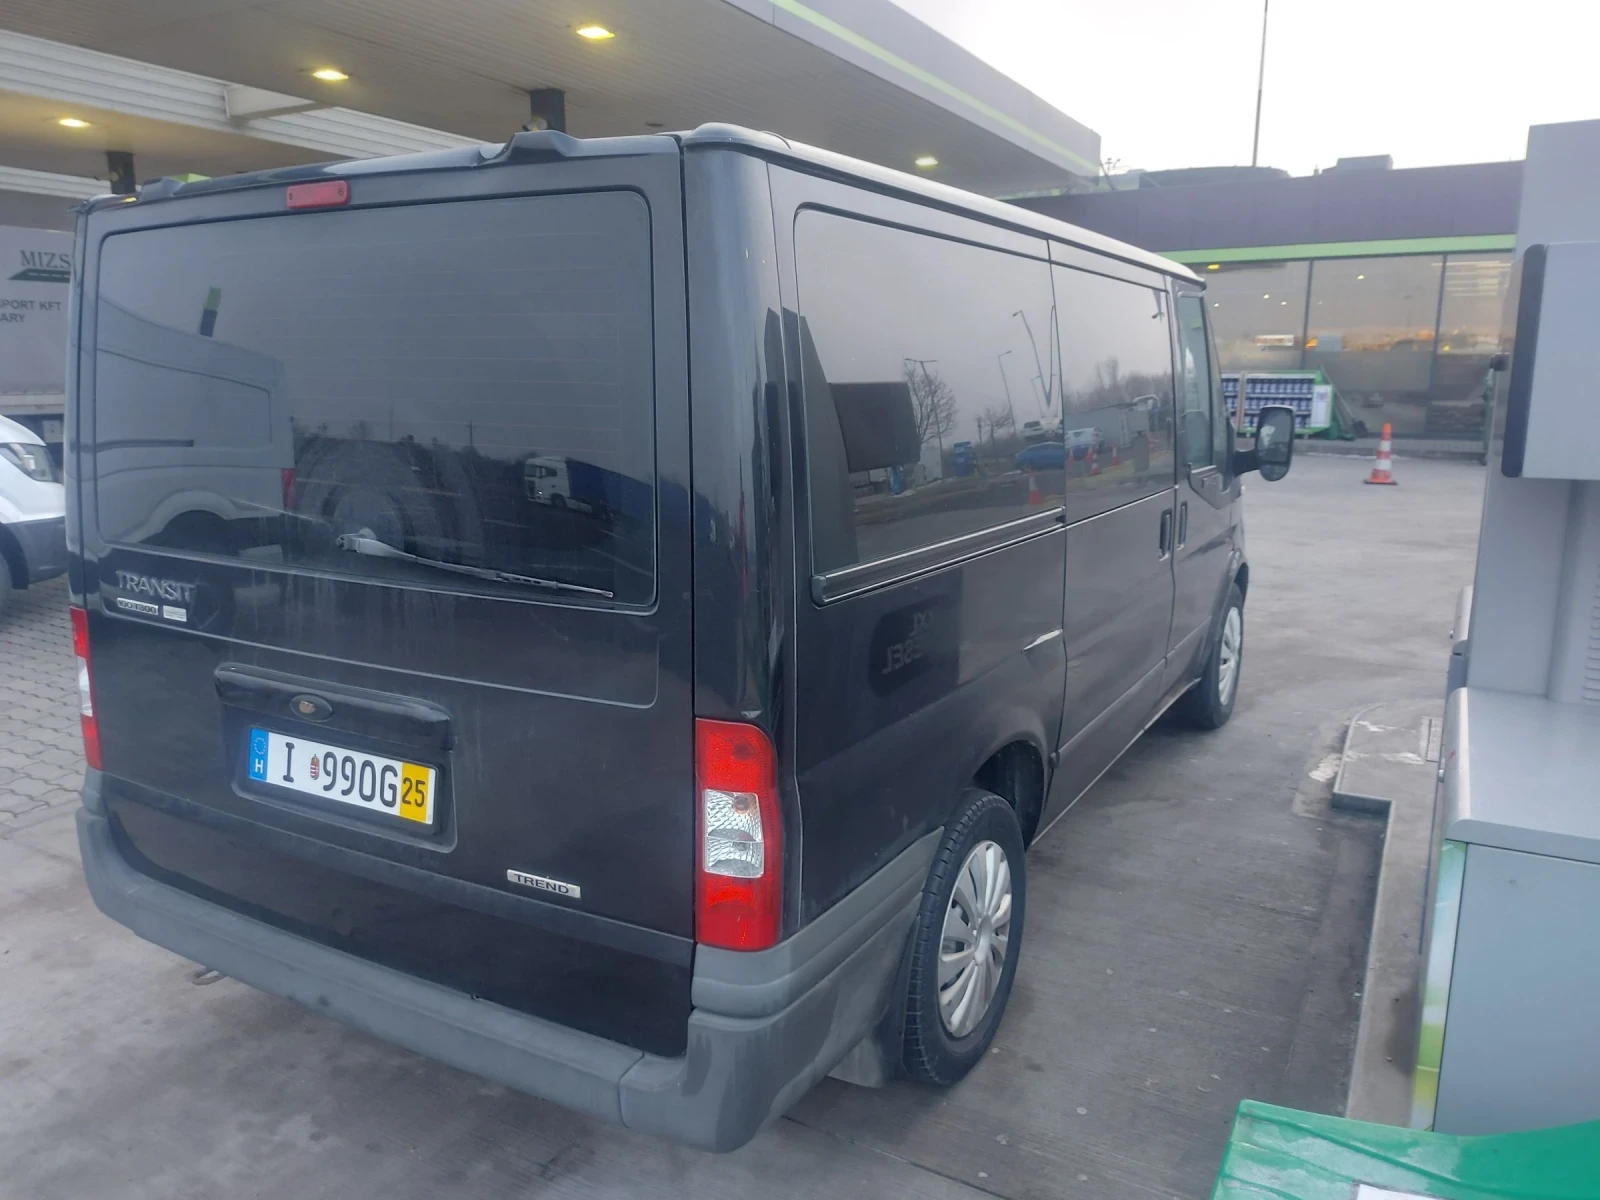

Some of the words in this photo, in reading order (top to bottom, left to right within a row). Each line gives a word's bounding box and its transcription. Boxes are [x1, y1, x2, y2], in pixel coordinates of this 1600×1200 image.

[39, 301, 61, 311] KFT
[116, 570, 195, 602] TRANSIT
[254, 758, 264, 774] H
[322, 751, 398, 808] 990G
[401, 777, 427, 808] 25
[514, 873, 569, 894] TREND
